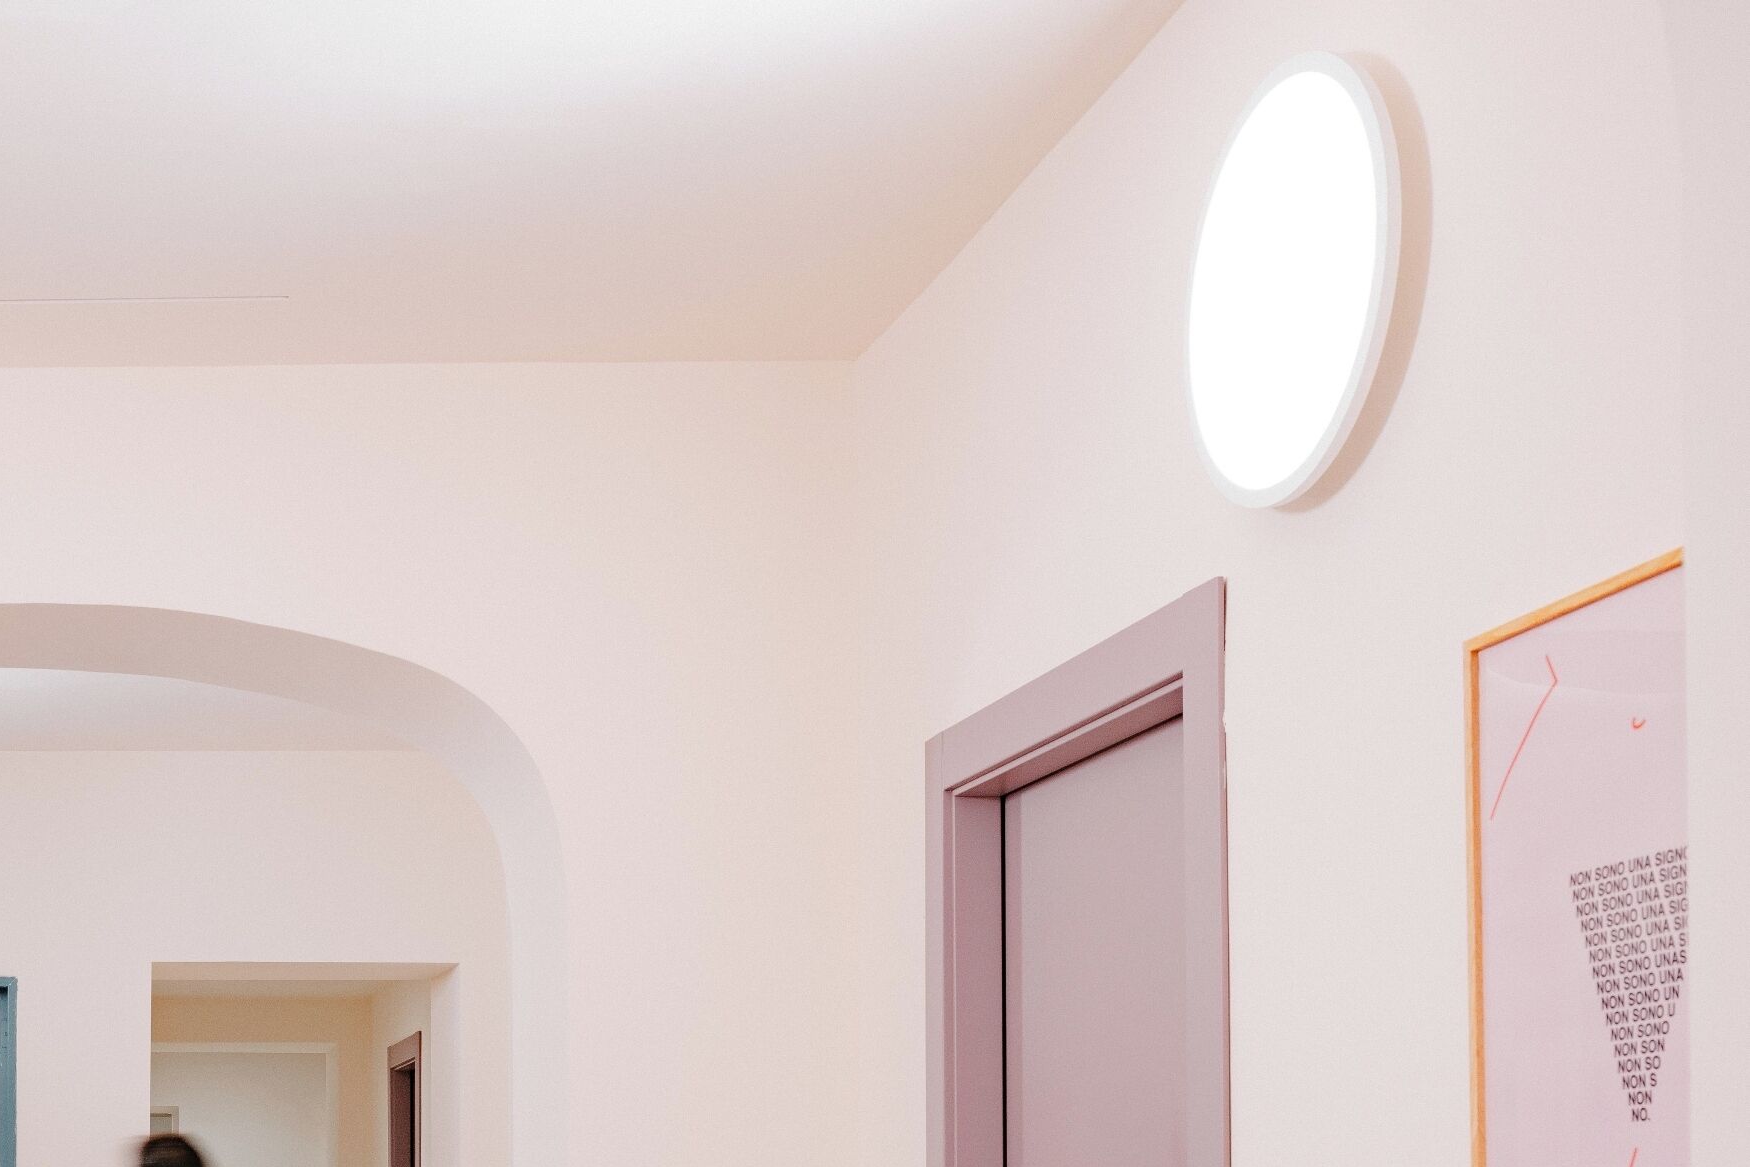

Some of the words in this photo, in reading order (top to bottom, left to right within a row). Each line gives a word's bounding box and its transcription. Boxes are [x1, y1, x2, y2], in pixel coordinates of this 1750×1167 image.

[1570, 869, 1592, 886] NON
[1595, 862, 1624, 881] SONO
[1628, 855, 1651, 873] UNA
[1573, 885, 1594, 902] NON
[1599, 877, 1628, 896] SONO
[1632, 871, 1655, 888] UNA
[1576, 900, 1598, 918] NON
[1602, 893, 1633, 912] SONO
[1636, 887, 1659, 904] UNA
[1581, 916, 1603, 933] NON
[1607, 908, 1638, 927] SONO
[1641, 903, 1665, 920] UNA
[1586, 932, 1606, 948] NON
[1611, 924, 1642, 942] SONO
[1646, 919, 1670, 936] UNA
[1674, 916, 1687, 930] SI
[1590, 948, 1611, 964] NON
[1616, 940, 1646, 958] SONO
[1650, 935, 1675, 952] UNA
[1679, 932, 1686, 947] S
[1593, 963, 1615, 979] NON
[1619, 956, 1651, 974] SONO
[1597, 978, 1620, 995] NON
[1624, 972, 1655, 990] SONO
[1659, 968, 1683, 984] UNA
[1602, 994, 1624, 1010] NON
[1629, 988, 1660, 1006] SONO
[1664, 985, 1679, 1000] UN
[1606, 1010, 1629, 1026] NON
[1633, 1005, 1664, 1022] SONO
[1668, 1003, 1675, 1017] U
[1611, 1026, 1633, 1042] NON
[1638, 1021, 1669, 1037] SONO
[1615, 1042, 1637, 1057] NON
[1641, 1037, 1665, 1054] SON
[1618, 1058, 1641, 1074] NON
[1645, 1056, 1660, 1070] SO
[1623, 1075, 1646, 1090] NON
[1650, 1073, 1657, 1086] S
[1628, 1090, 1652, 1105] NON
[1632, 1108, 1650, 1122] NO.
